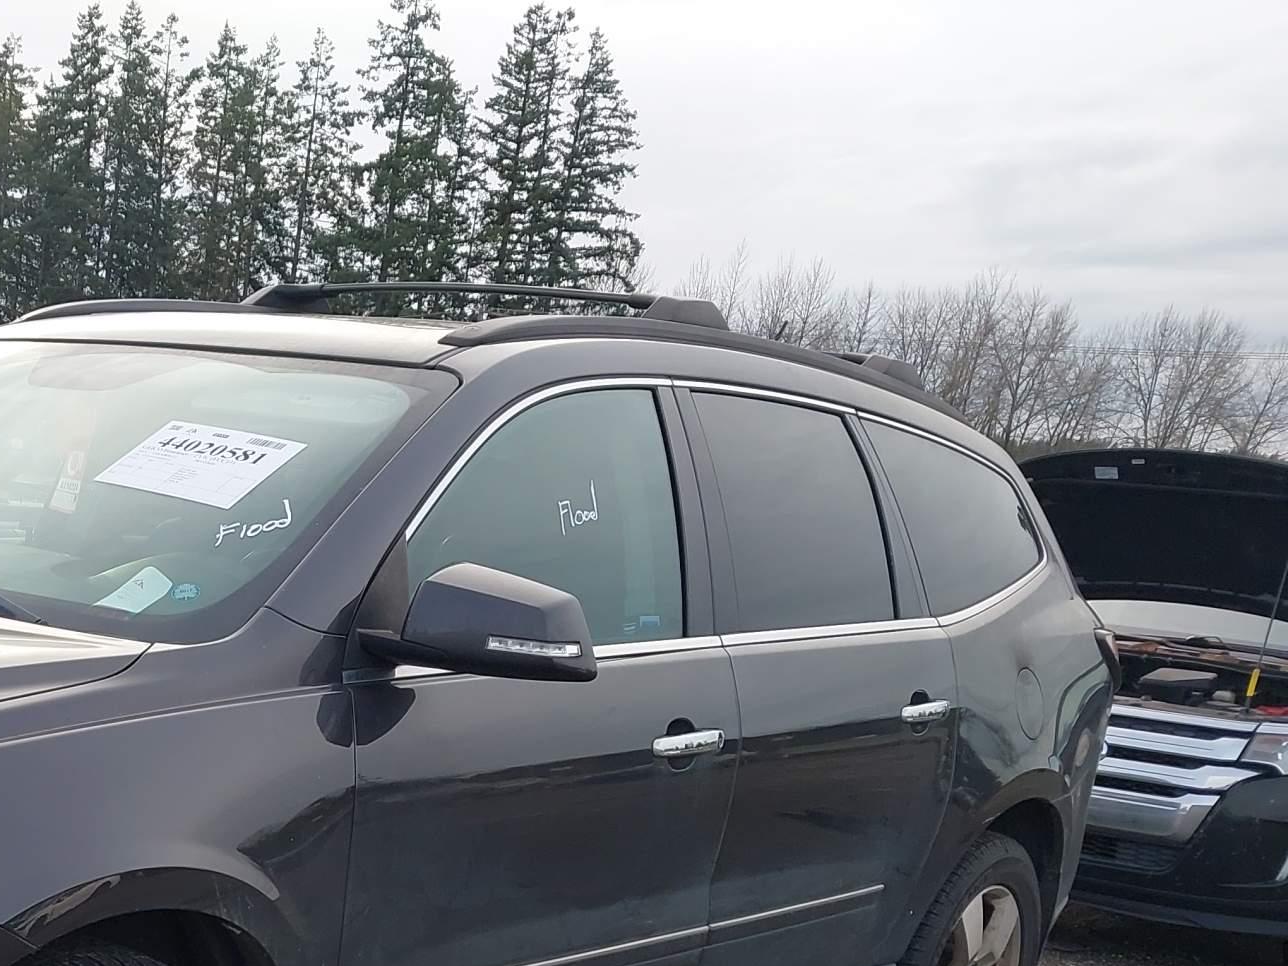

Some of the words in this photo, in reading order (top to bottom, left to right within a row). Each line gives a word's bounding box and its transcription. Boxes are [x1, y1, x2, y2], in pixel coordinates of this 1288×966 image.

[157, 436, 268, 465] 44020581
[214, 498, 292, 547] Flood
[558, 479, 598, 536] Flood
